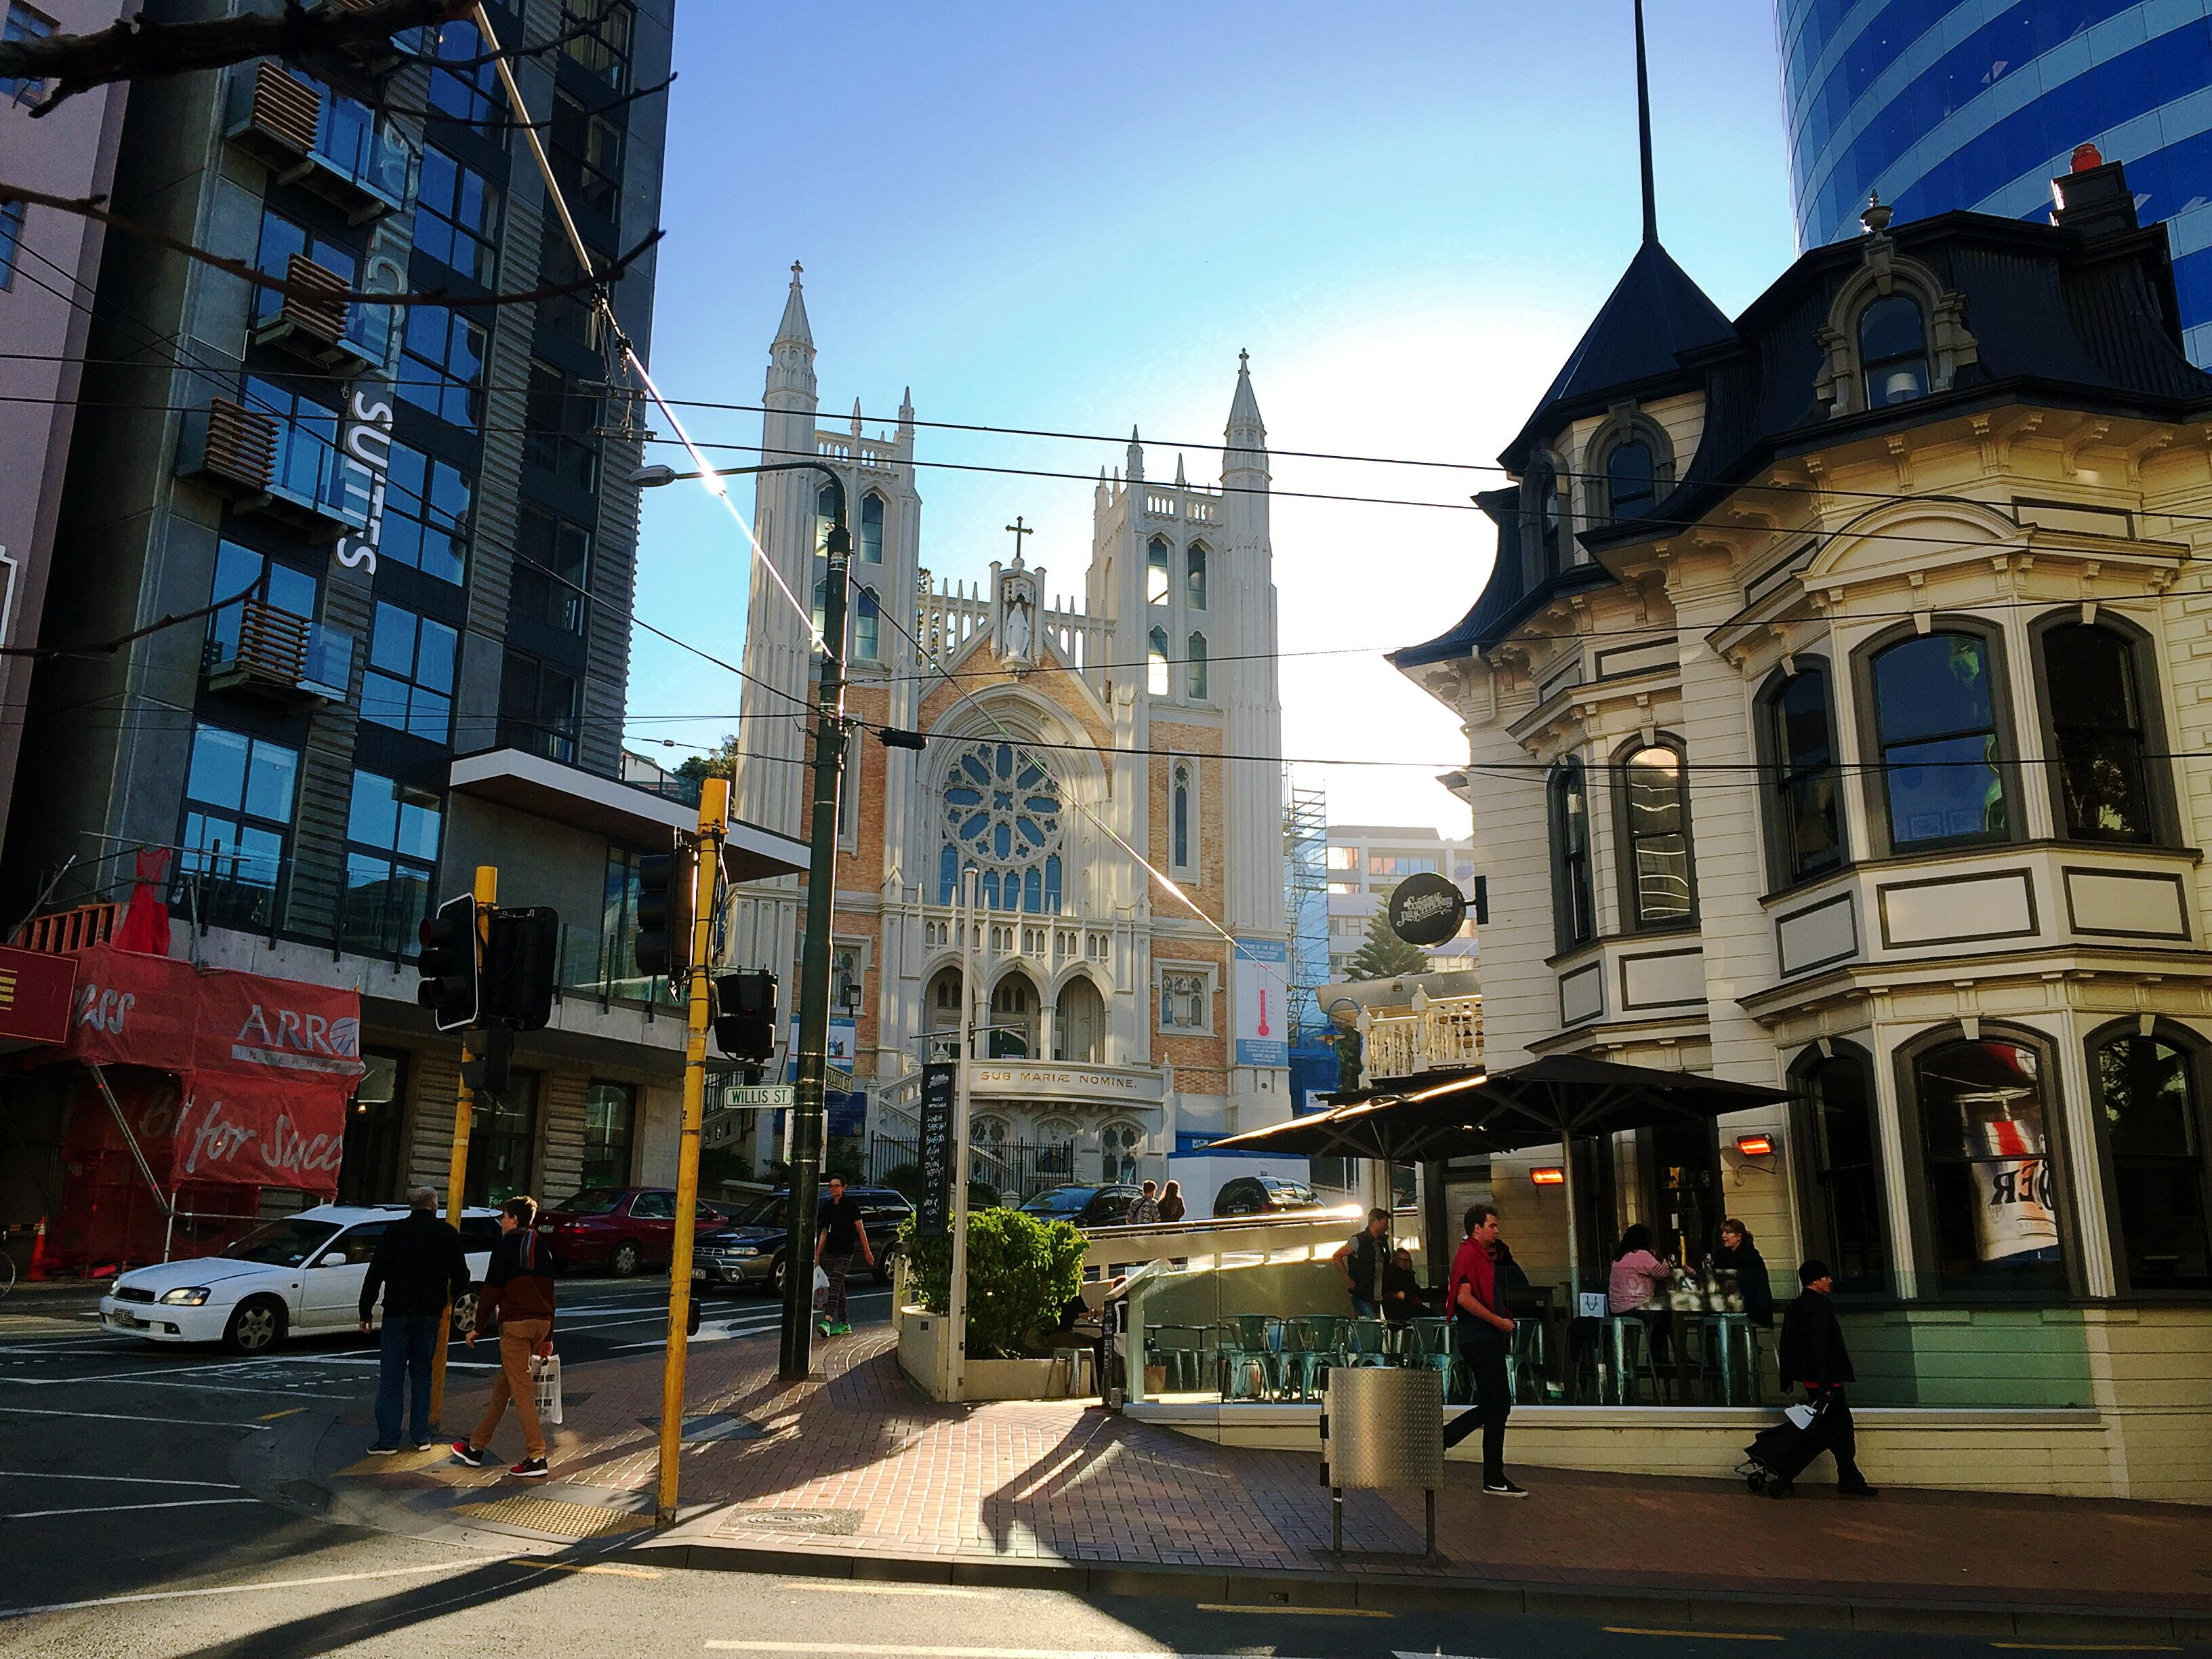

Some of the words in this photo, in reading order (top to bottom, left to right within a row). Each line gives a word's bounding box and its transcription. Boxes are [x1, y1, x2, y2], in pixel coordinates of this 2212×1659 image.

[337, 391, 393, 575] SUITES
[732, 1090, 769, 1104] WILLIS
[774, 1089, 787, 1103] ST
[981, 1071, 1012, 1080] SUB
[1021, 1072, 1071, 1082] MARIÆ
[1080, 1075, 1137, 1088] NOMINE.
[186, 1101, 258, 1174] for
